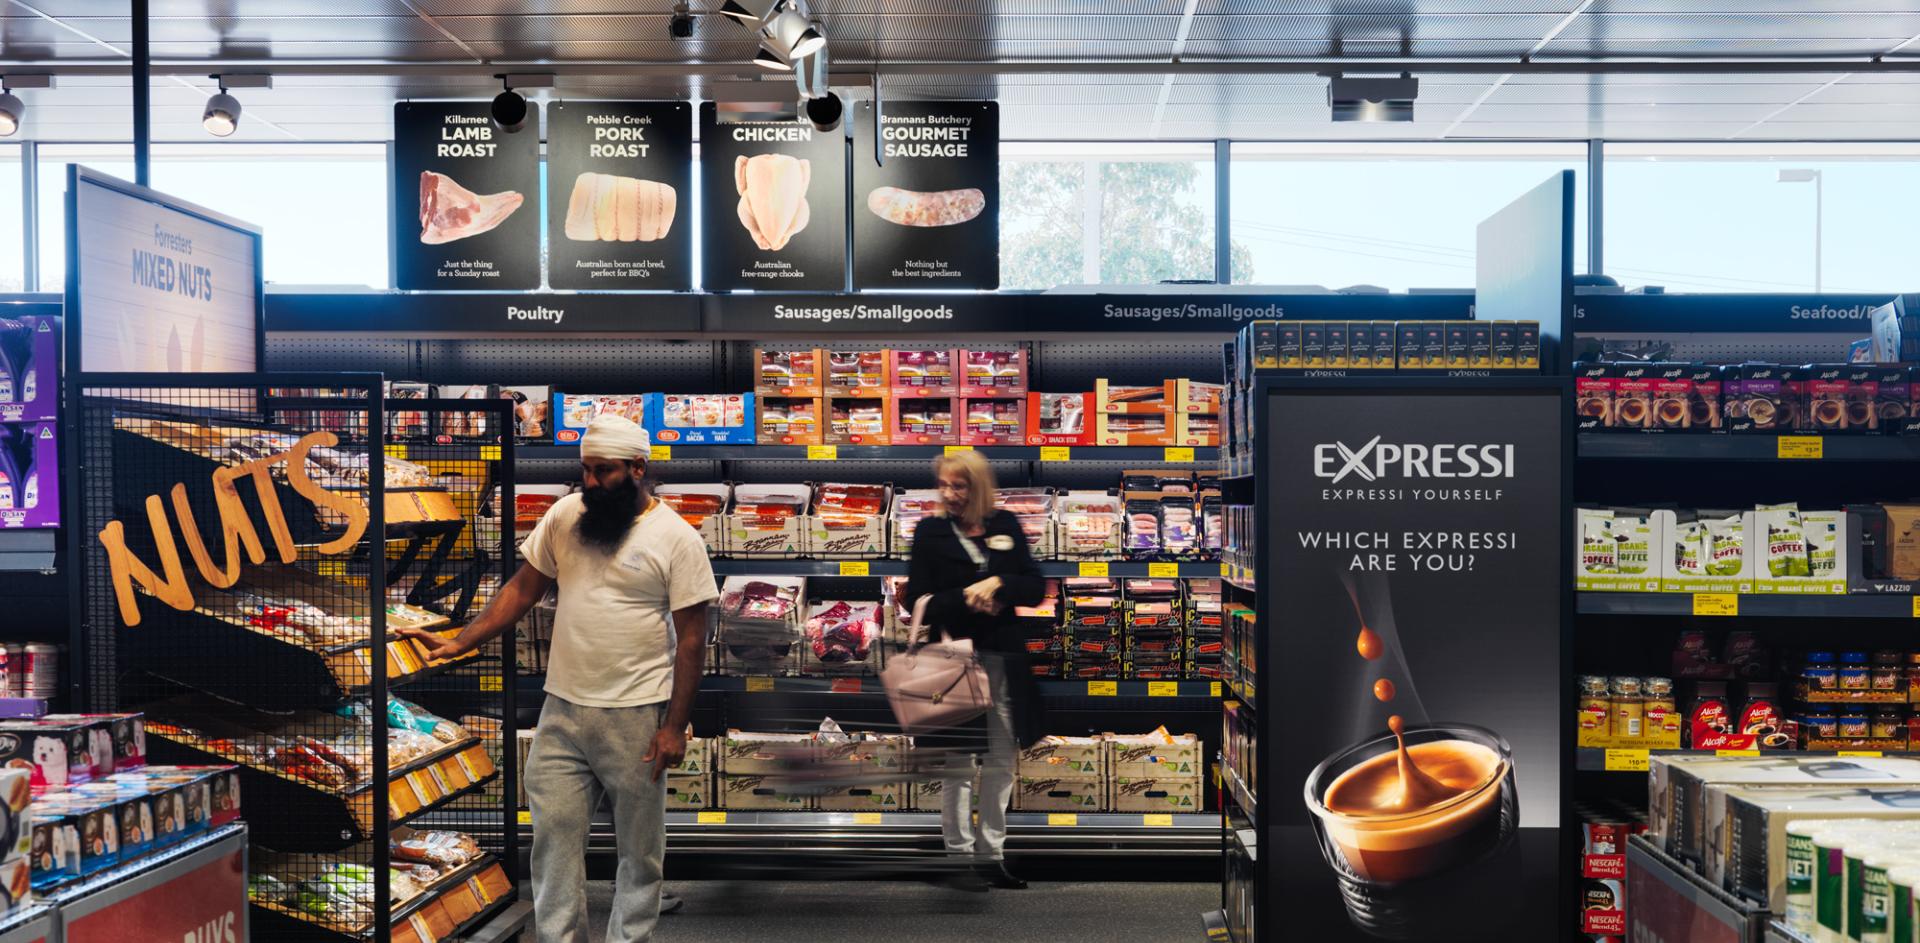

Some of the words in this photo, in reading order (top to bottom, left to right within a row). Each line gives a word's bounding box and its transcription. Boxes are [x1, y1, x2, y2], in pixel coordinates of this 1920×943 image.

[445, 115, 488, 124] Killarnee
[587, 115, 621, 124] Pebble
[623, 115, 652, 124] Creek
[881, 115, 926, 124] Brannans
[928, 115, 972, 126] Butchery
[442, 127, 492, 141] LAMB
[595, 127, 644, 141] PORK
[732, 127, 812, 141] CHICKEN
[882, 127, 971, 141] GOURMET
[437, 144, 497, 157] ROAST
[590, 144, 650, 157] ROAST
[885, 144, 968, 157] SAUSAGE
[154, 224, 192, 255] Forresters
[444, 260, 457, 269] Just
[458, 260, 470, 269] the
[471, 260, 493, 271] thing
[576, 260, 613, 269] Australian
[615, 260, 631, 269] born
[632, 260, 646, 269] and
[647, 260, 665, 270] bred,
[754, 260, 791, 269] Australian
[905, 260, 934, 271] Nothing
[936, 260, 948, 269] but
[132, 248, 175, 292] MIXED
[179, 261, 212, 302] NUTS
[437, 269, 447, 277] for
[454, 269, 479, 279] Sunday
[481, 270, 500, 278] roast
[591, 269, 614, 279] perfect
[616, 269, 627, 278] for
[742, 269, 783, 280] free-range
[784, 269, 804, 278] chooks
[892, 269, 903, 278] the
[905, 269, 920, 278] best
[921, 269, 961, 280] ingredients
[507, 306, 564, 322] Poultry
[774, 304, 953, 322] Sausages/Smallgoods
[1104, 303, 1284, 321] Sausages/Smallgoods
[1314, 435, 1514, 484] EXPRESSI
[1322, 489, 1402, 500] EXPRESSI
[1413, 489, 1503, 500] YOURSELF
[98, 431, 369, 627] NUTS
[1298, 532, 1389, 549] WHICH
[1403, 532, 1516, 549] EXPRESSI
[1771, 544, 1803, 554] COFFEE
[1349, 554, 1396, 571] ARE
[1409, 554, 1475, 571] YOU?
[1885, 584, 1911, 592] LAZZIO
[1703, 735, 1727, 747] Alcafé
